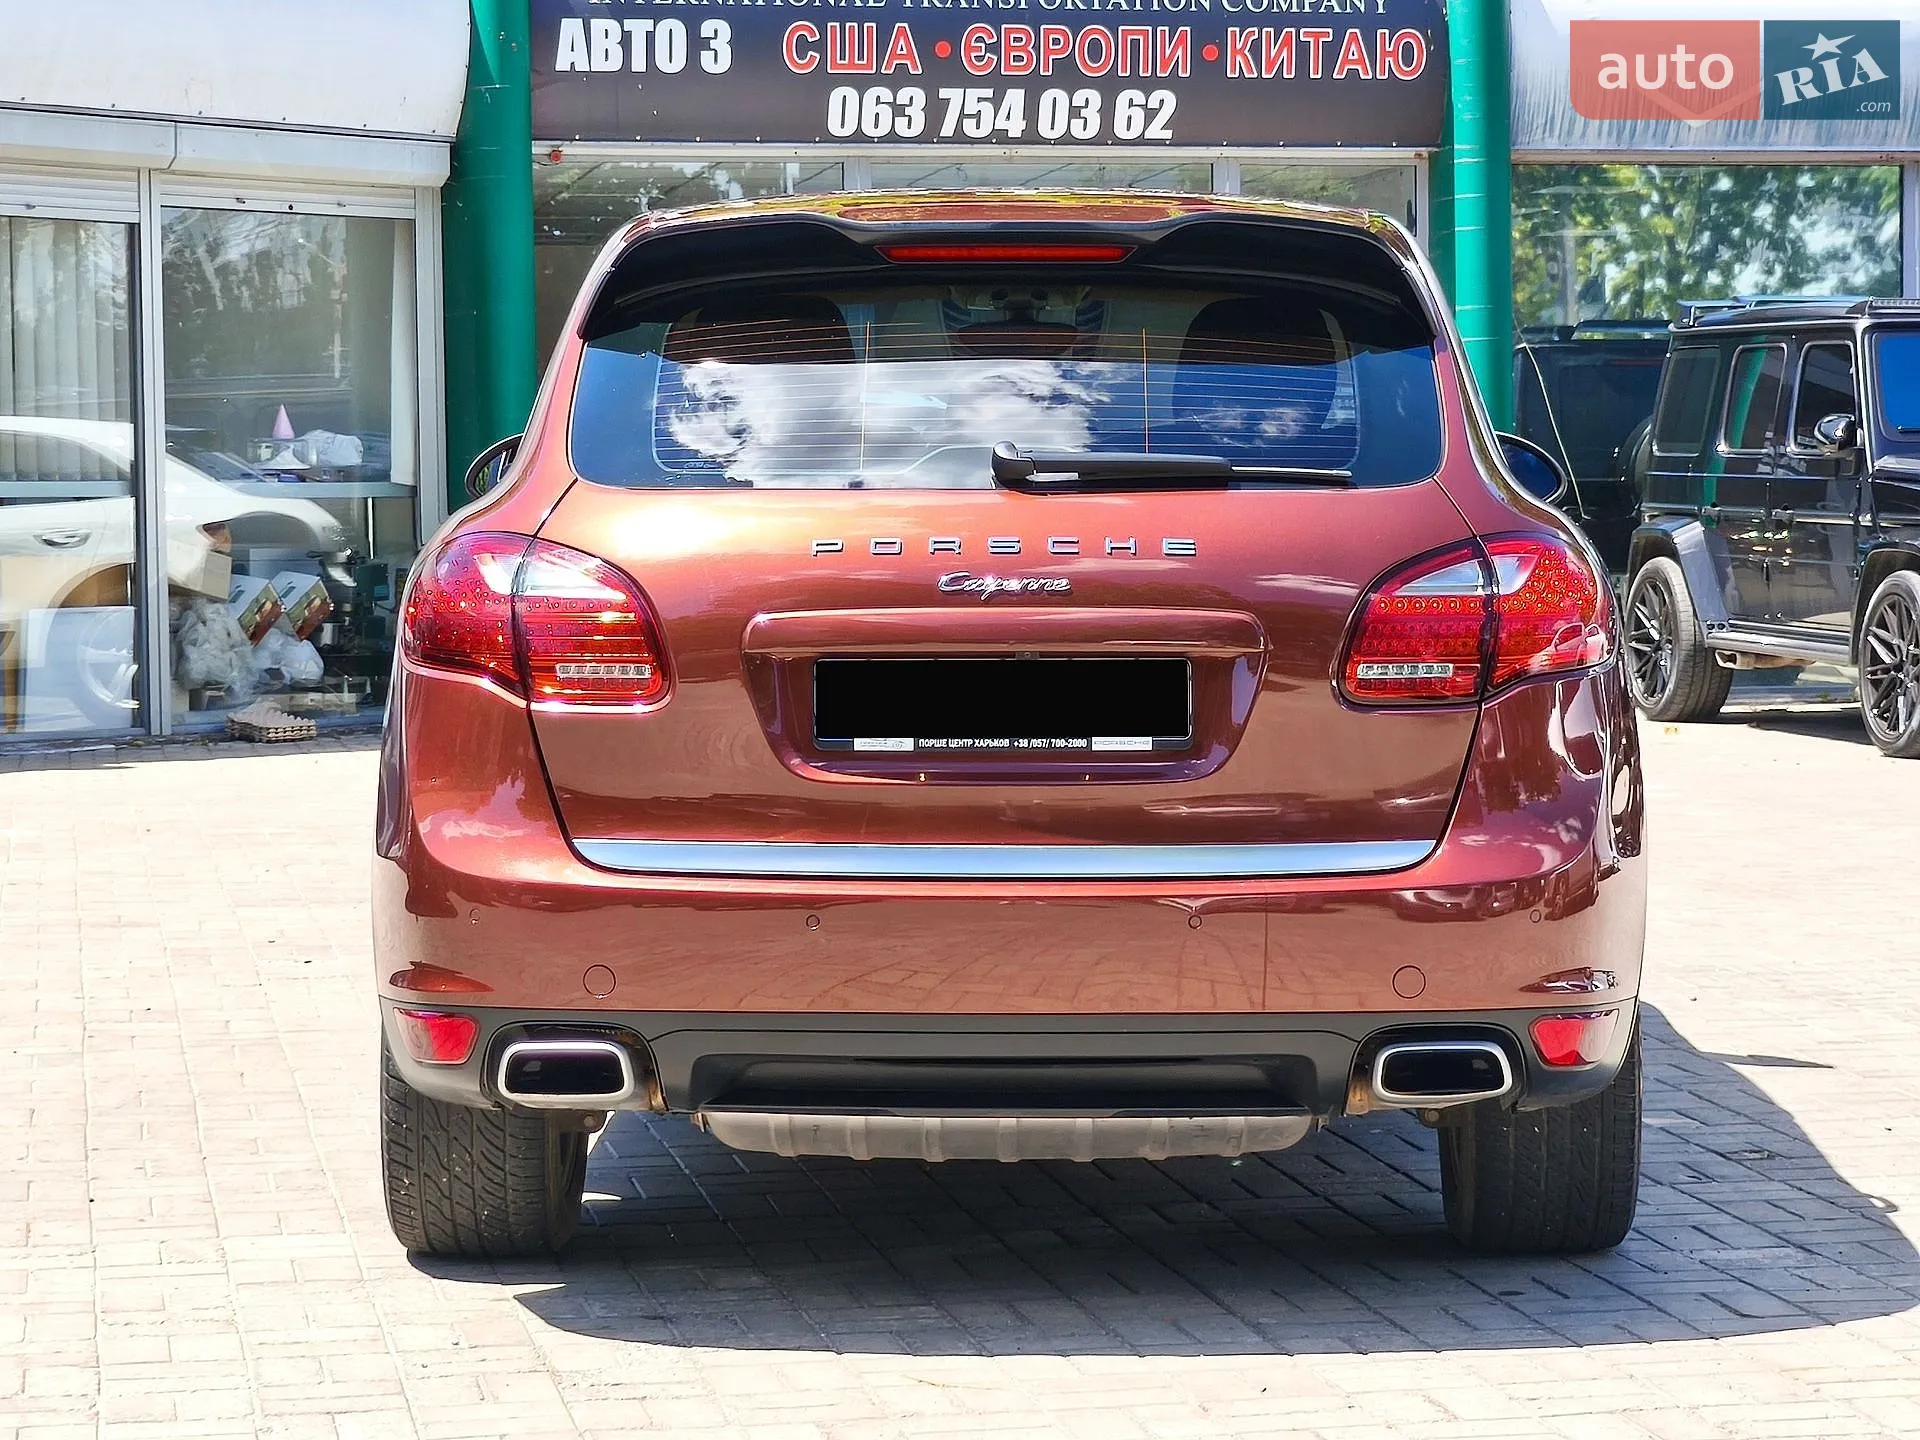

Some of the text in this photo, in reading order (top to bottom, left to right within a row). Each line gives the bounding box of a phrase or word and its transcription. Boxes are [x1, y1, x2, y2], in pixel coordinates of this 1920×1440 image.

[555, 18, 689, 73] АВТО
[782, 22, 923, 75] США
[961, 23, 1192, 77] ЄВРОПИ
[1226, 27, 1427, 80] КИТАЮ
[826, 87, 1177, 140] 063 754 03 62
[811, 536, 1197, 556] PORSCHE
[937, 571, 1072, 600] Cayenne
[918, 738, 948, 748] ПОРШЕ
[949, 738, 973, 749] ЦЕНТР
[974, 738, 1010, 748] ХАРЬКОВ
[1014, 738, 1029, 748] +38
[1051, 738, 1088, 748] 700-2000
